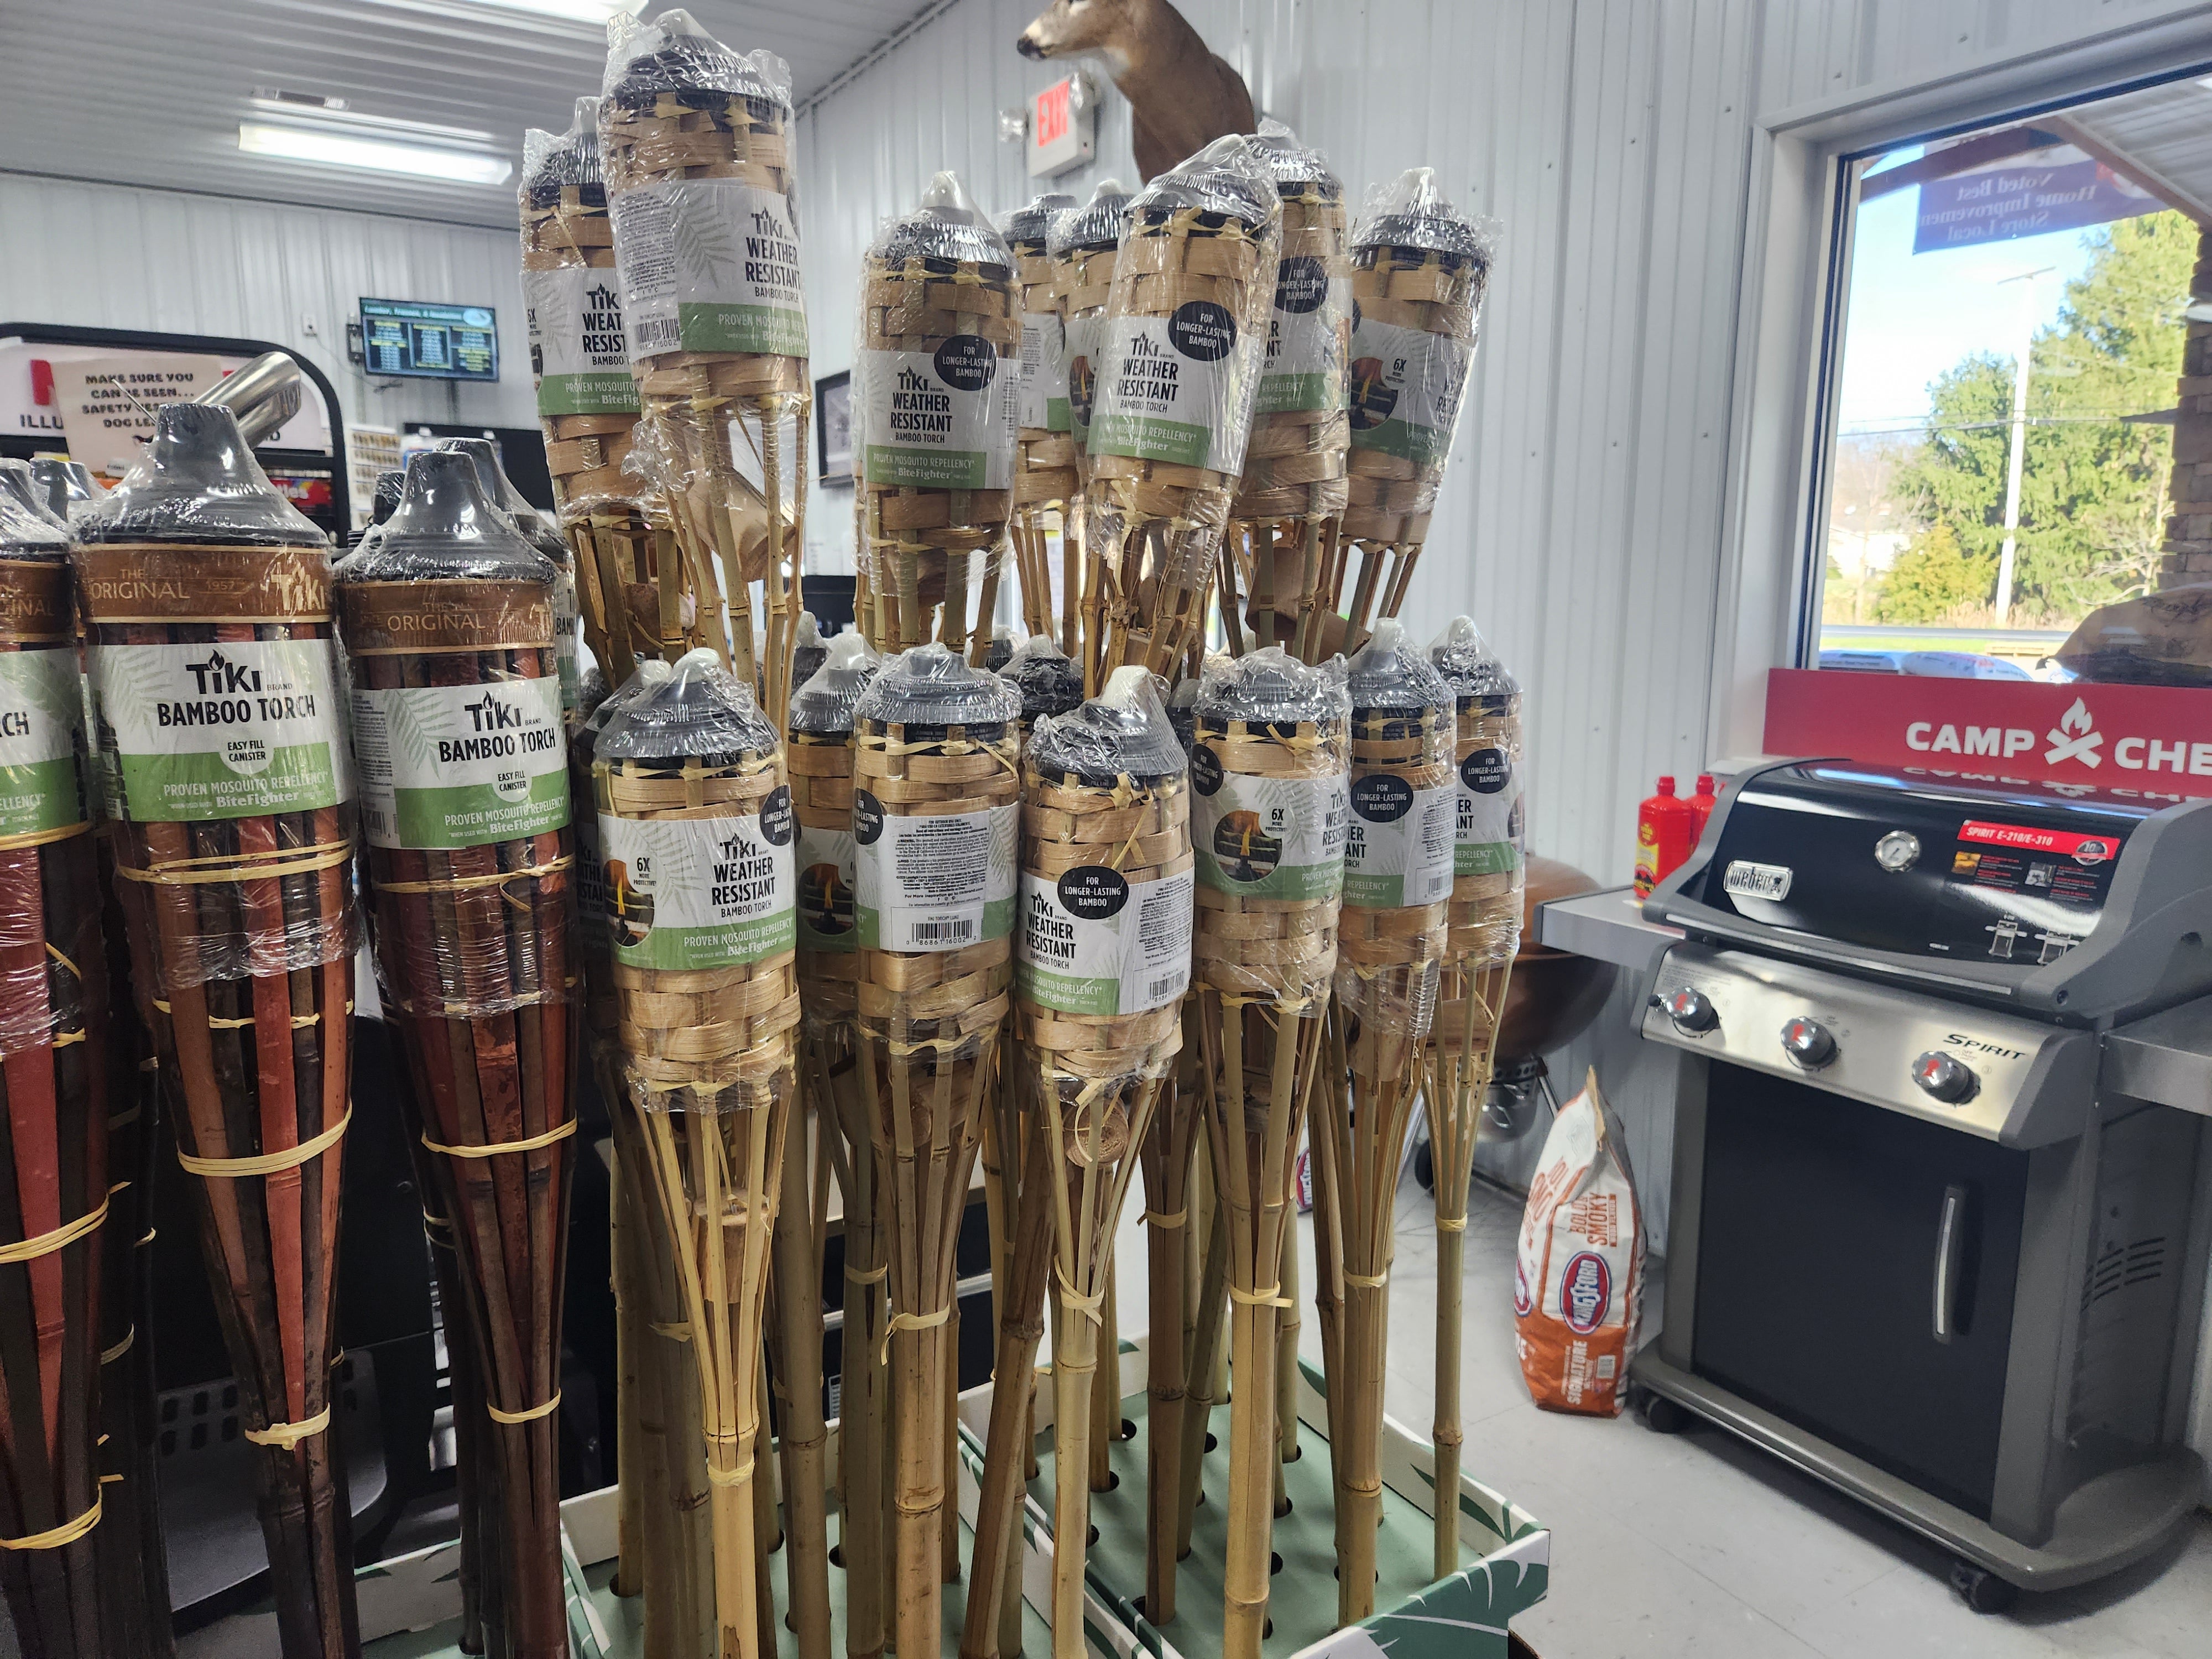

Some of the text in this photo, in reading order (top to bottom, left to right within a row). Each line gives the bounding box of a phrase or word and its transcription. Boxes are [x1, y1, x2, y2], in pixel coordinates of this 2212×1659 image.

[1037, 81, 1070, 147] EXIT
[746, 237, 798, 267] WEATHER
[745, 261, 800, 290] RESISTANT
[586, 283, 619, 310] TIK
[755, 286, 782, 300] BAMBOO
[1286, 291, 1313, 300] BAMBOO
[582, 313, 621, 331] WEAT
[718, 314, 753, 326] PROVEN
[1200, 314, 1213, 324] FOR
[1177, 321, 1231, 340] LONGER-LASTING
[582, 335, 627, 352] RESIST
[1188, 335, 1217, 348] BAMBOO
[964, 346, 975, 355] FOR
[592, 356, 624, 366] BAMBOO
[942, 357, 992, 368] LONGER-LASTING
[1393, 358, 1407, 373] 6X
[956, 368, 982, 377] BAMBOO
[1123, 358, 1178, 381] WEATHER
[85, 373, 194, 385] MAKE SURE YOU
[91, 389, 120, 399] CAN
[566, 382, 635, 393] PROVEN MOSQUITO
[1117, 380, 1178, 402] RESISTANT
[602, 395, 640, 406] BiteFig
[893, 392, 950, 412] WEATHER
[1120, 399, 1167, 413] BAMBOO TORCH
[82, 405, 131, 414] SAFETY
[103, 419, 131, 427] DOG
[891, 413, 952, 432] RESISTANT
[896, 432, 945, 443] BAMBOO TORCH
[874, 453, 893, 463] PROVEN
[895, 455, 928, 466] MOSQUITO
[898, 467, 952, 480] BiteFighter
[91, 582, 190, 599] ORIGINAL
[388, 614, 486, 632] ORIGINAL
[157, 695, 316, 727] BAMBOO TORCH
[227, 740, 265, 751] EASY FILL
[439, 728, 556, 763] BAMBOO TORCH
[1906, 722, 2034, 758] CAMP
[228, 752, 266, 762] CANISTER
[498, 771, 525, 782] EASY FILL
[164, 784, 207, 796] PROVEN
[211, 778, 268, 794] MOSQUITO
[499, 781, 526, 792] CANISTER
[216, 791, 298, 807] BiteFighter
[778, 798, 786, 808] FOR
[1357, 793, 1407, 802] LONGER-LASTING
[1271, 808, 1284, 821] 6X
[1369, 803, 1395, 811] BAMBOO
[445, 812, 482, 826] PROVEN
[486, 805, 529, 822] MOSQUITO
[489, 816, 549, 834] BiteFighter
[1966, 827, 2053, 846] SPIRIT E-210/E-310
[2085, 842, 2096, 852] 10
[637, 857, 650, 872] 6X
[713, 857, 773, 884] WEATHER
[1344, 860, 1359, 868] ORCH
[1086, 877, 1099, 885] FOR
[712, 877, 775, 906] RESISTANT
[1065, 886, 1121, 896] LONGER-LASTING
[721, 900, 772, 918] BAMBOO TORCH
[1078, 898, 1107, 907] BAMBOO
[1027, 912, 1073, 940] WEATHER
[684, 935, 718, 947] PROVEN
[721, 928, 760, 945] MOSQUITO
[1026, 930, 1077, 959] RESISTANT
[727, 937, 779, 957] BiteFighter
[1030, 950, 1070, 970] BAMBOO TORCH
[1032, 985, 1077, 1005] BiteFighter
[1943, 1033, 2030, 1061] SPIRIT
[1587, 1192, 1608, 1245] SMOKY
[1570, 1259, 1601, 1326] KINGSFORD
